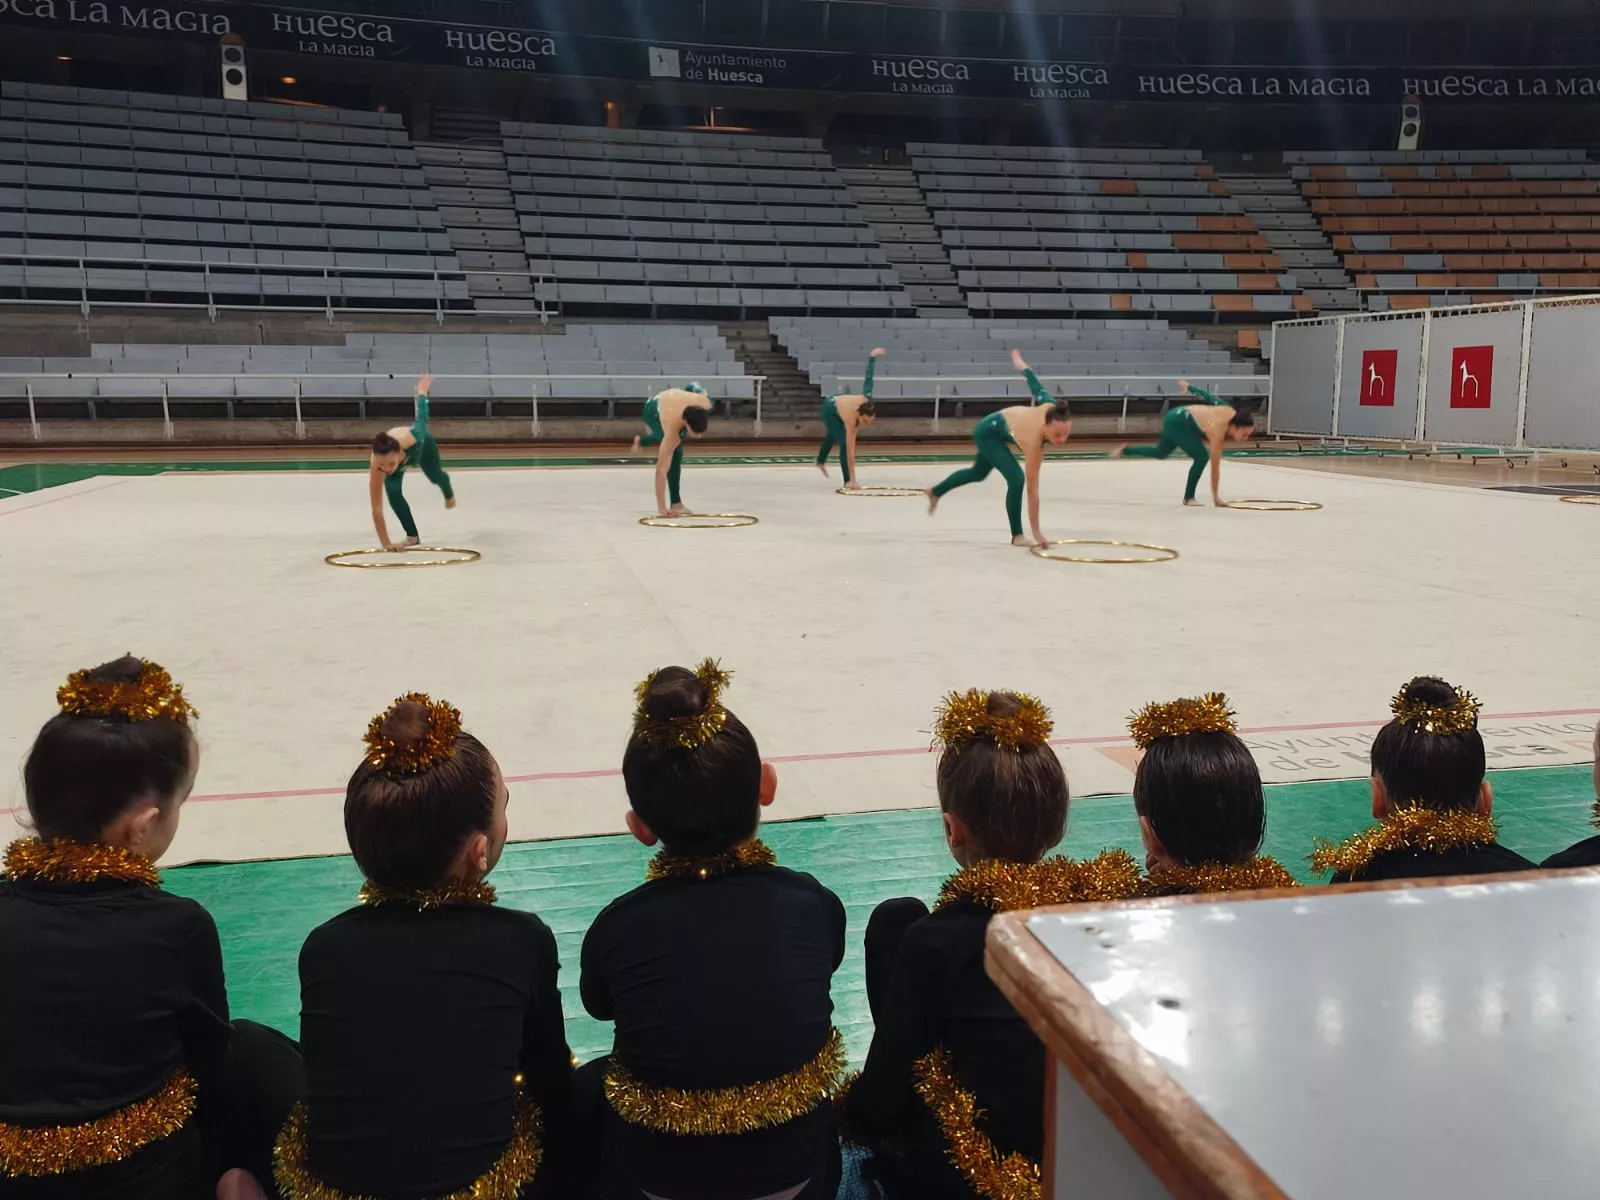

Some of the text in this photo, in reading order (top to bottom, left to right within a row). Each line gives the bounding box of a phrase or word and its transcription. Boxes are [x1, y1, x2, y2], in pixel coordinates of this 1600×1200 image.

[68, 0, 111, 23] La
[684, 49, 787, 70] Ayuntamiento
[684, 68, 764, 84] de Huesca
[1250, 77, 1282, 96] La
[1518, 79, 1549, 96] La
[1269, 755, 1341, 771] de
